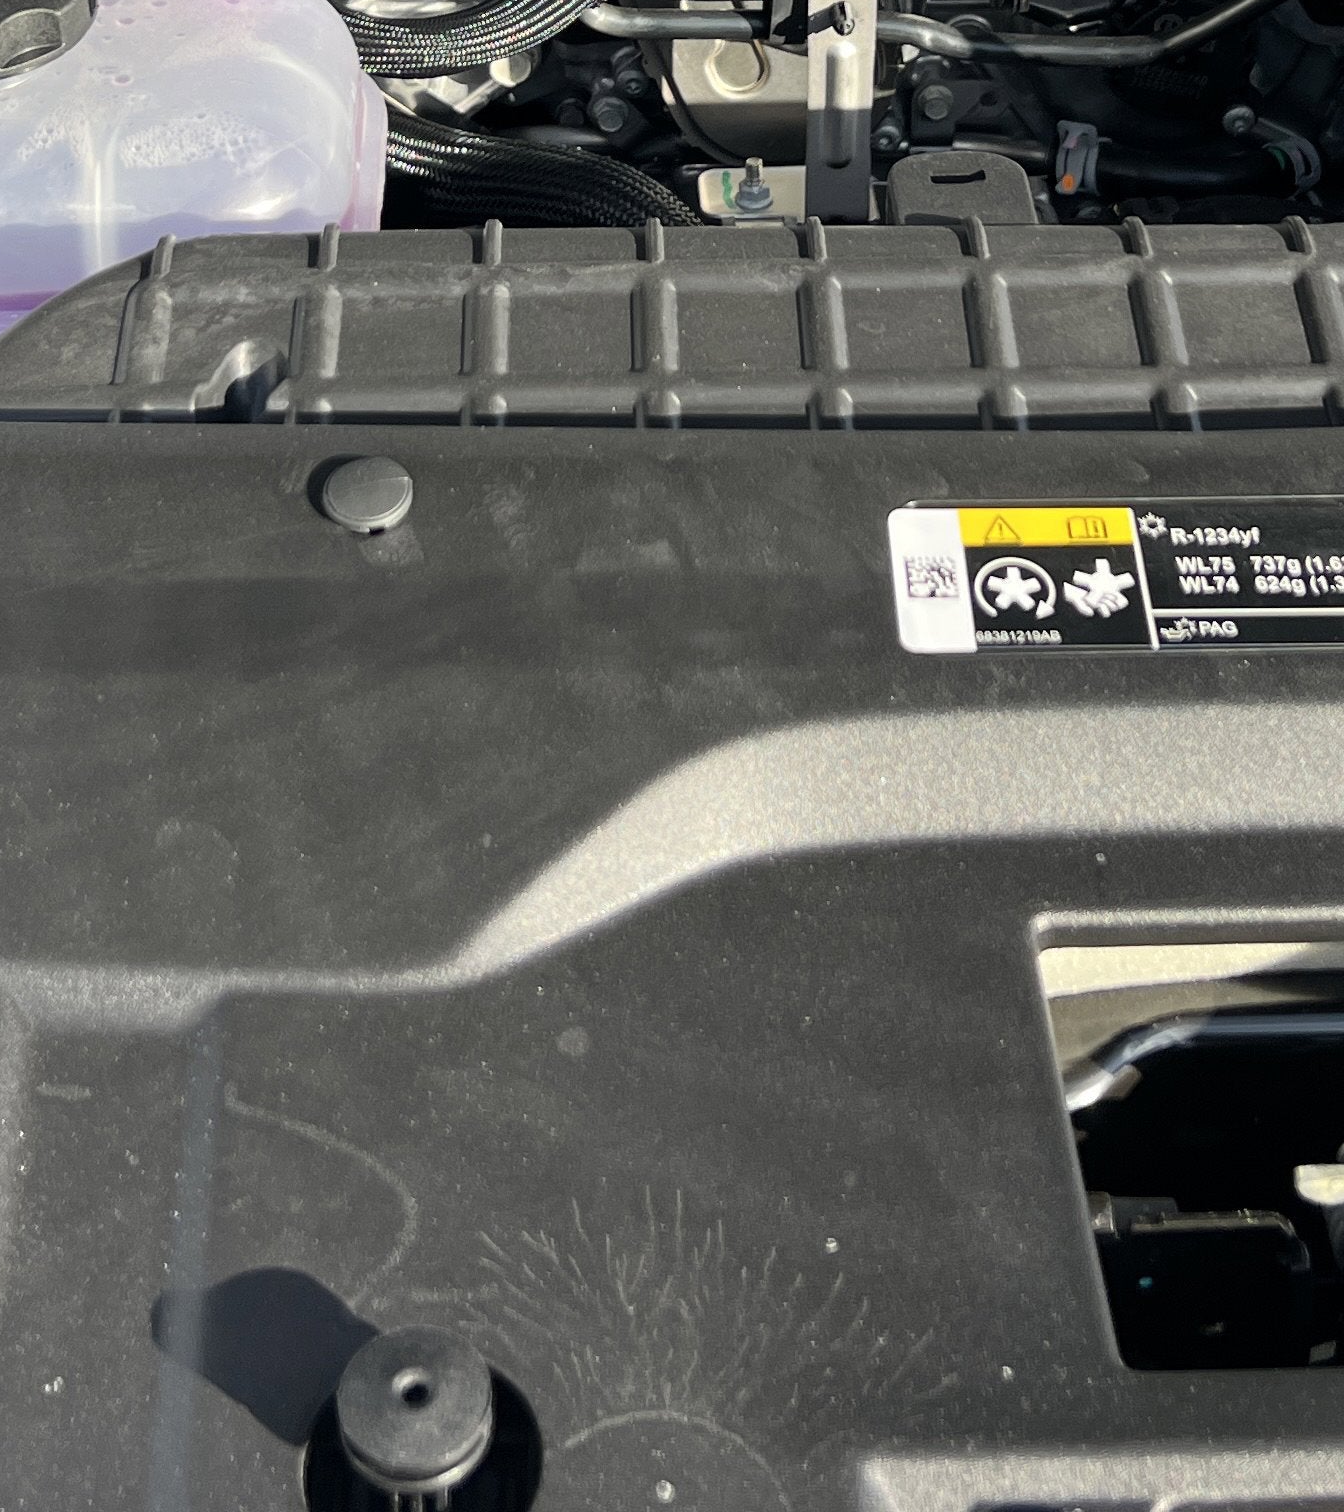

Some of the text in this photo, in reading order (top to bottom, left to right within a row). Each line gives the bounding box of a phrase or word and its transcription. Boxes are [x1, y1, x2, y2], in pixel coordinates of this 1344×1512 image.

[1170, 526, 1260, 548] R-1234yf
[1175, 556, 1236, 575] WL75
[1250, 556, 1302, 575] 737g
[1178, 575, 1240, 595] WL74
[1254, 575, 1306, 595] 624g
[1198, 621, 1239, 638] PAG
